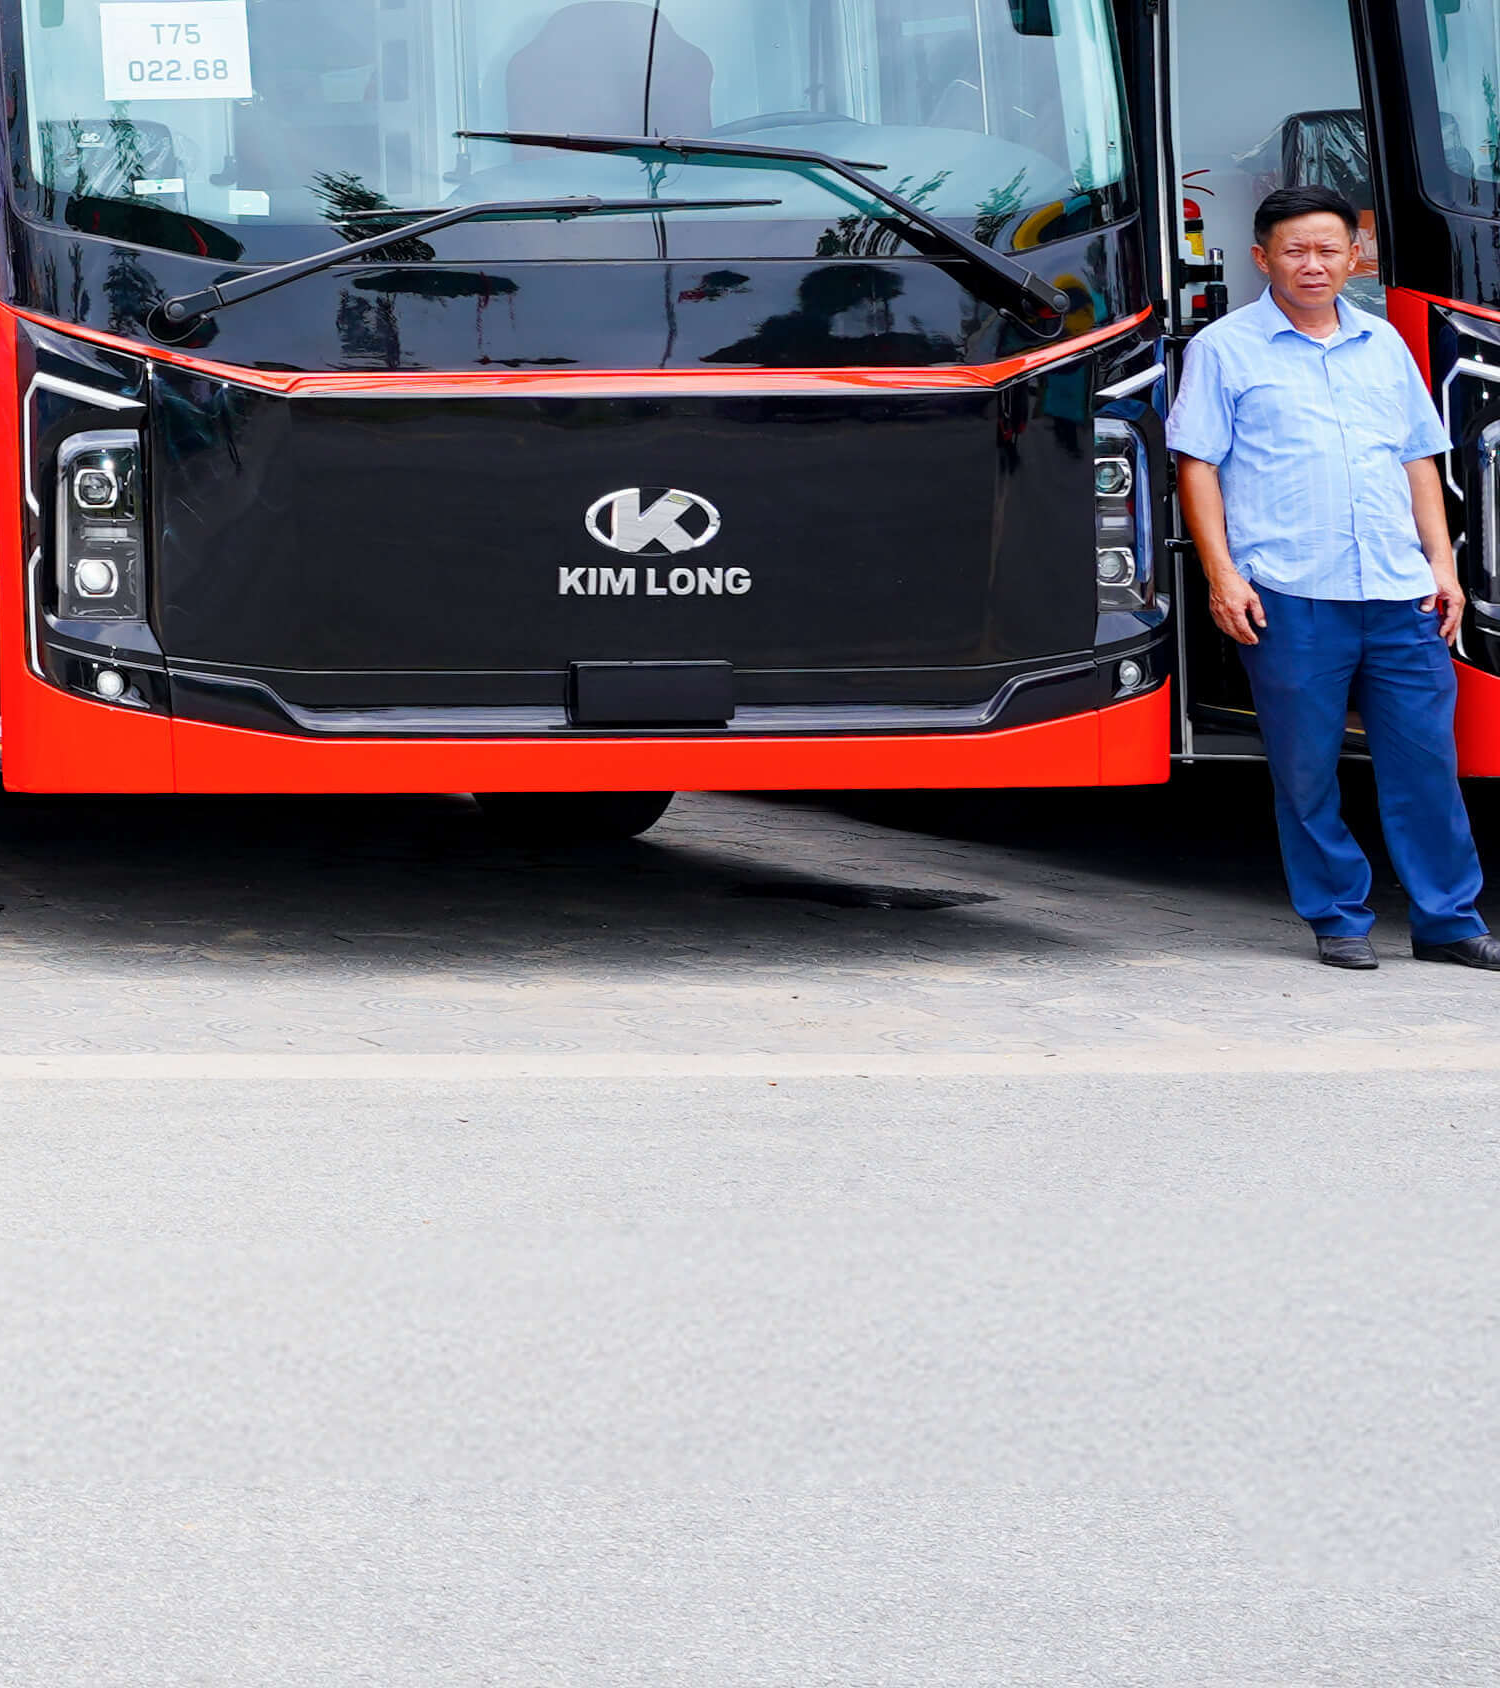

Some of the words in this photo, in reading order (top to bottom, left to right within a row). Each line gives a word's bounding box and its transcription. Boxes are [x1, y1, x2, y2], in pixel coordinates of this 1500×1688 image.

[149, 23, 202, 45] T75
[127, 58, 229, 83] 022.68
[559, 566, 636, 596] KIM
[646, 566, 752, 596] LONG
